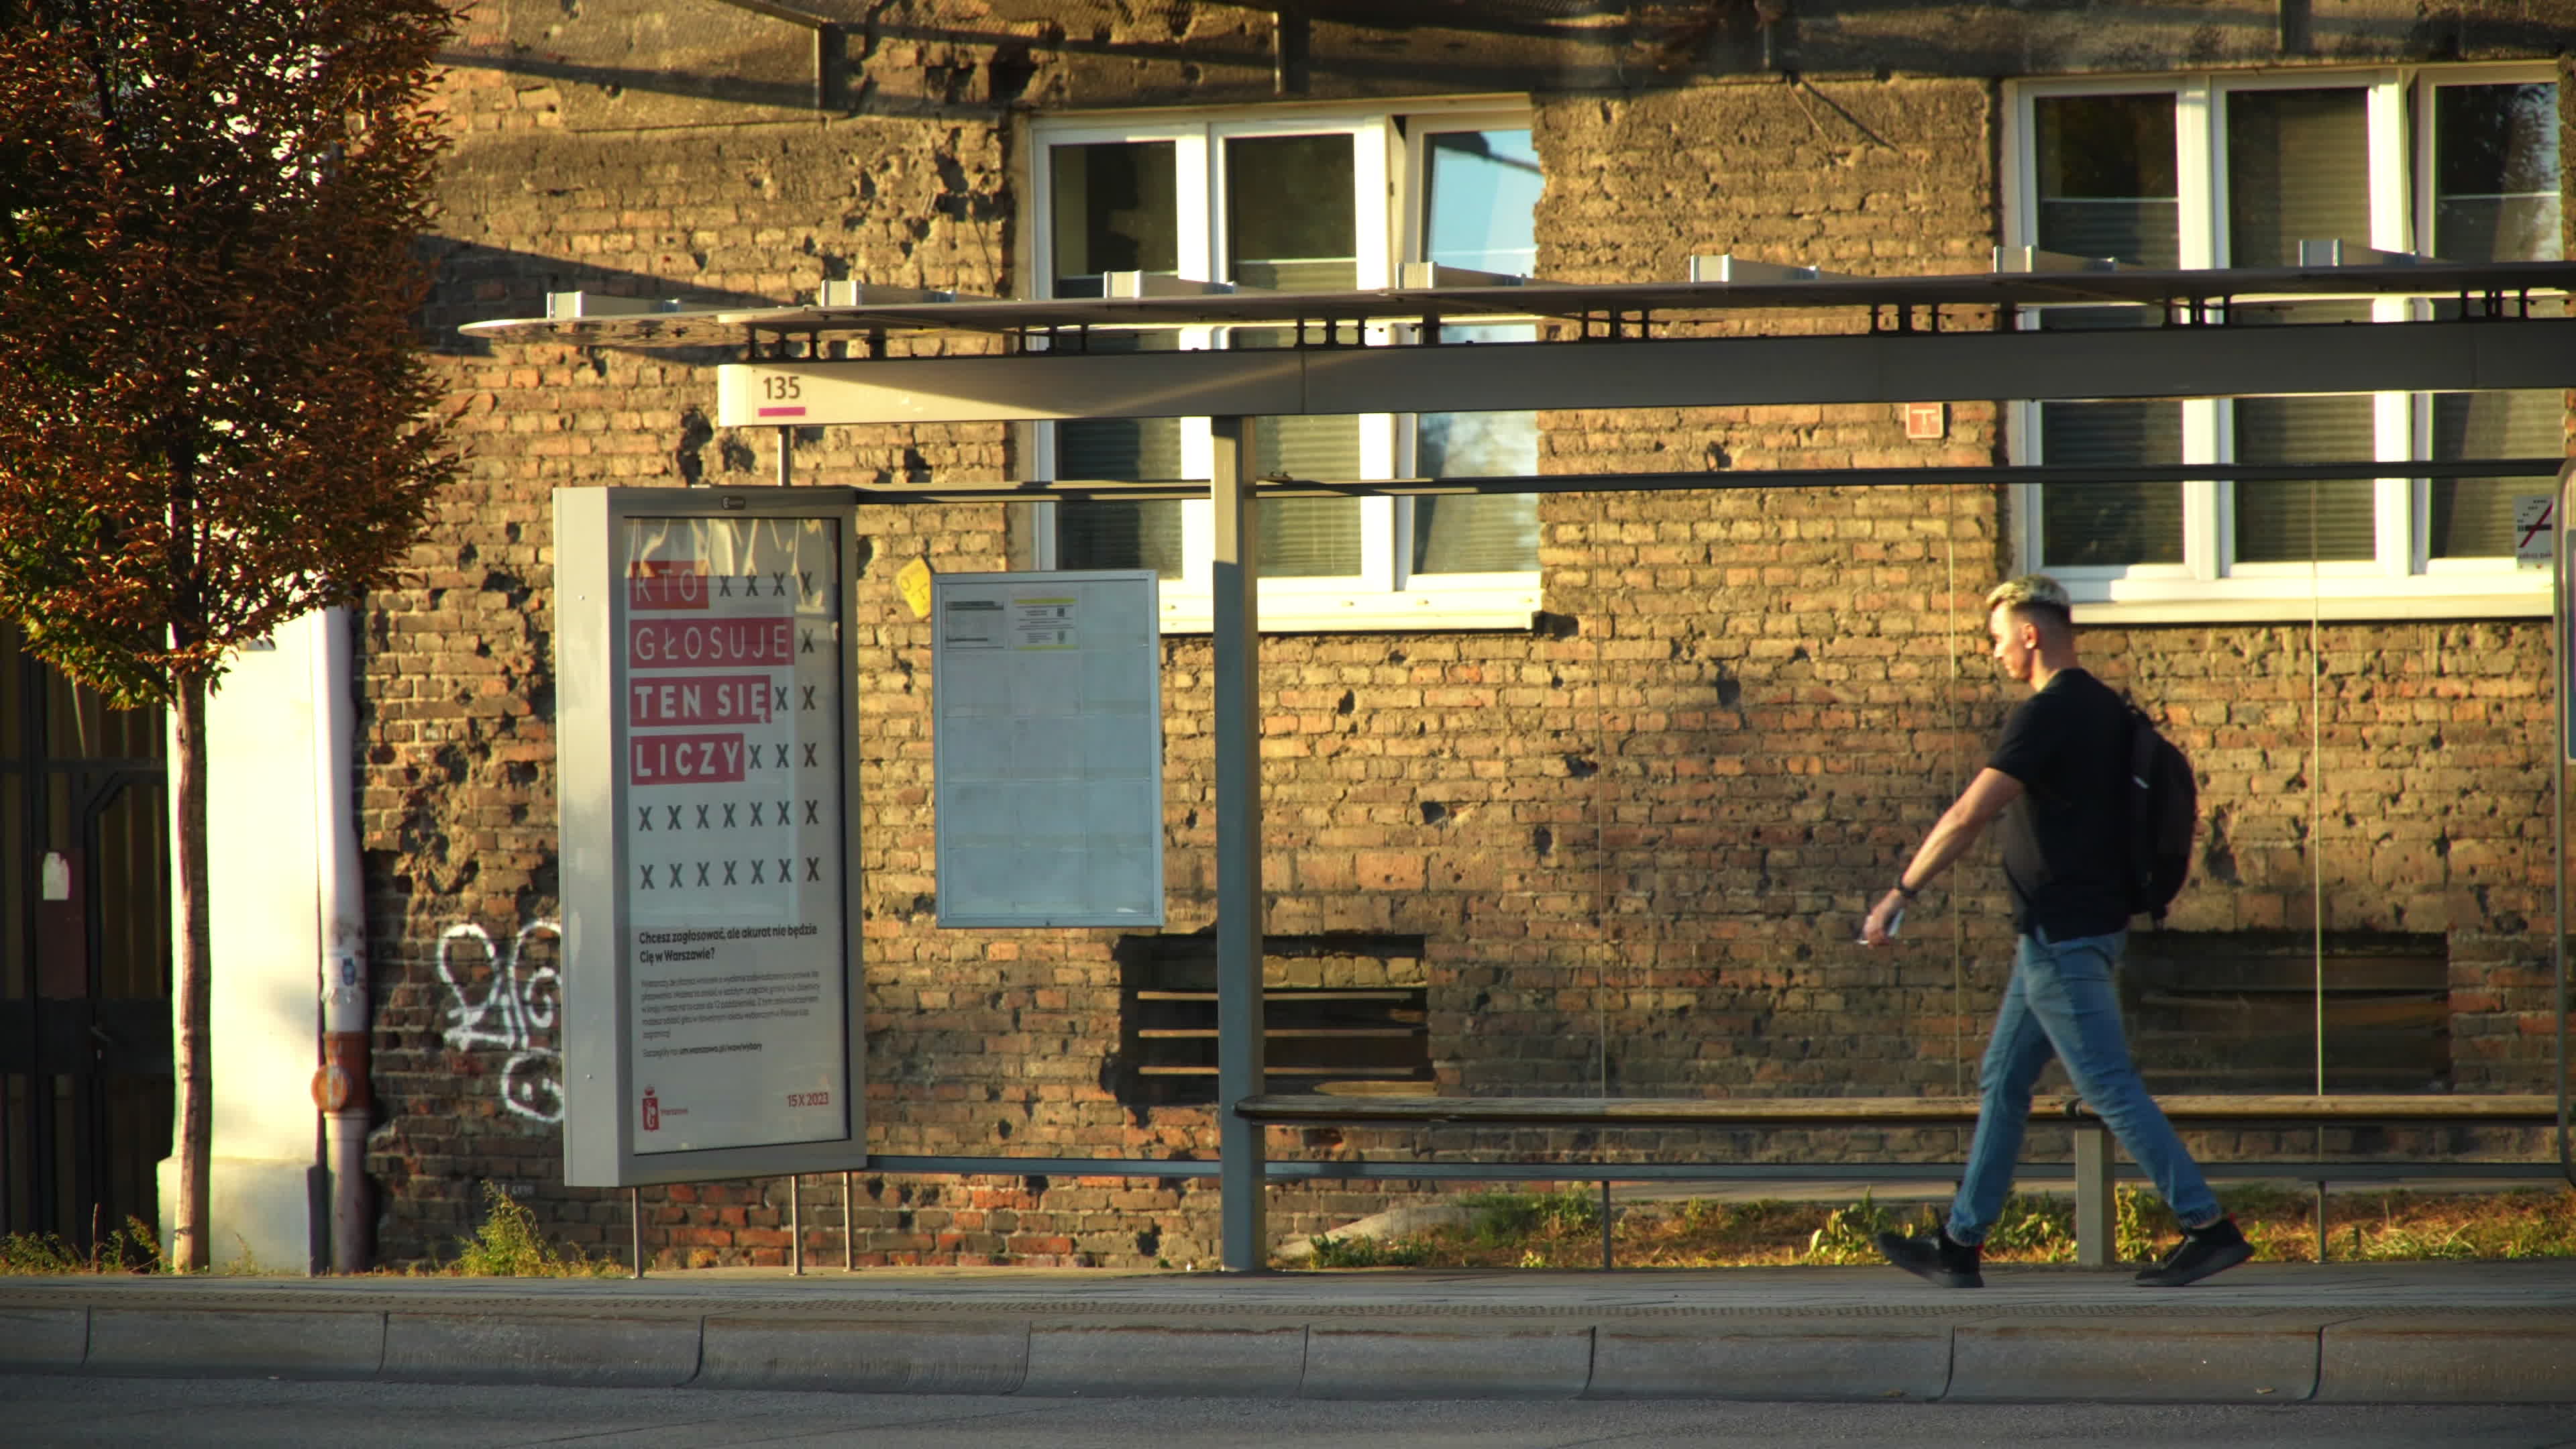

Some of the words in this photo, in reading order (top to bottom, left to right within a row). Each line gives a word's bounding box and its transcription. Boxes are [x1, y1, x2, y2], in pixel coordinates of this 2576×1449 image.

[763, 376, 800, 400] 135
[636, 570, 698, 602] KTO
[637, 625, 788, 660] GŁOSUJE
[634, 685, 702, 718] TEN
[717, 683, 766, 723] SIĘ
[636, 742, 740, 777] LICZY
[639, 932, 670, 944] Chcesz
[672, 927, 727, 945] zagłosować,
[727, 927, 740, 939] ale
[741, 926, 771, 938] akurat
[773, 924, 786, 936] nie
[788, 923, 817, 938] będzie
[640, 951, 654, 966] Cię
[655, 952, 663, 963] w
[664, 947, 715, 961] Warszawie?
[787, 1094, 796, 1108] 15
[798, 1093, 806, 1106] X
[807, 1091, 828, 1106] 2023
